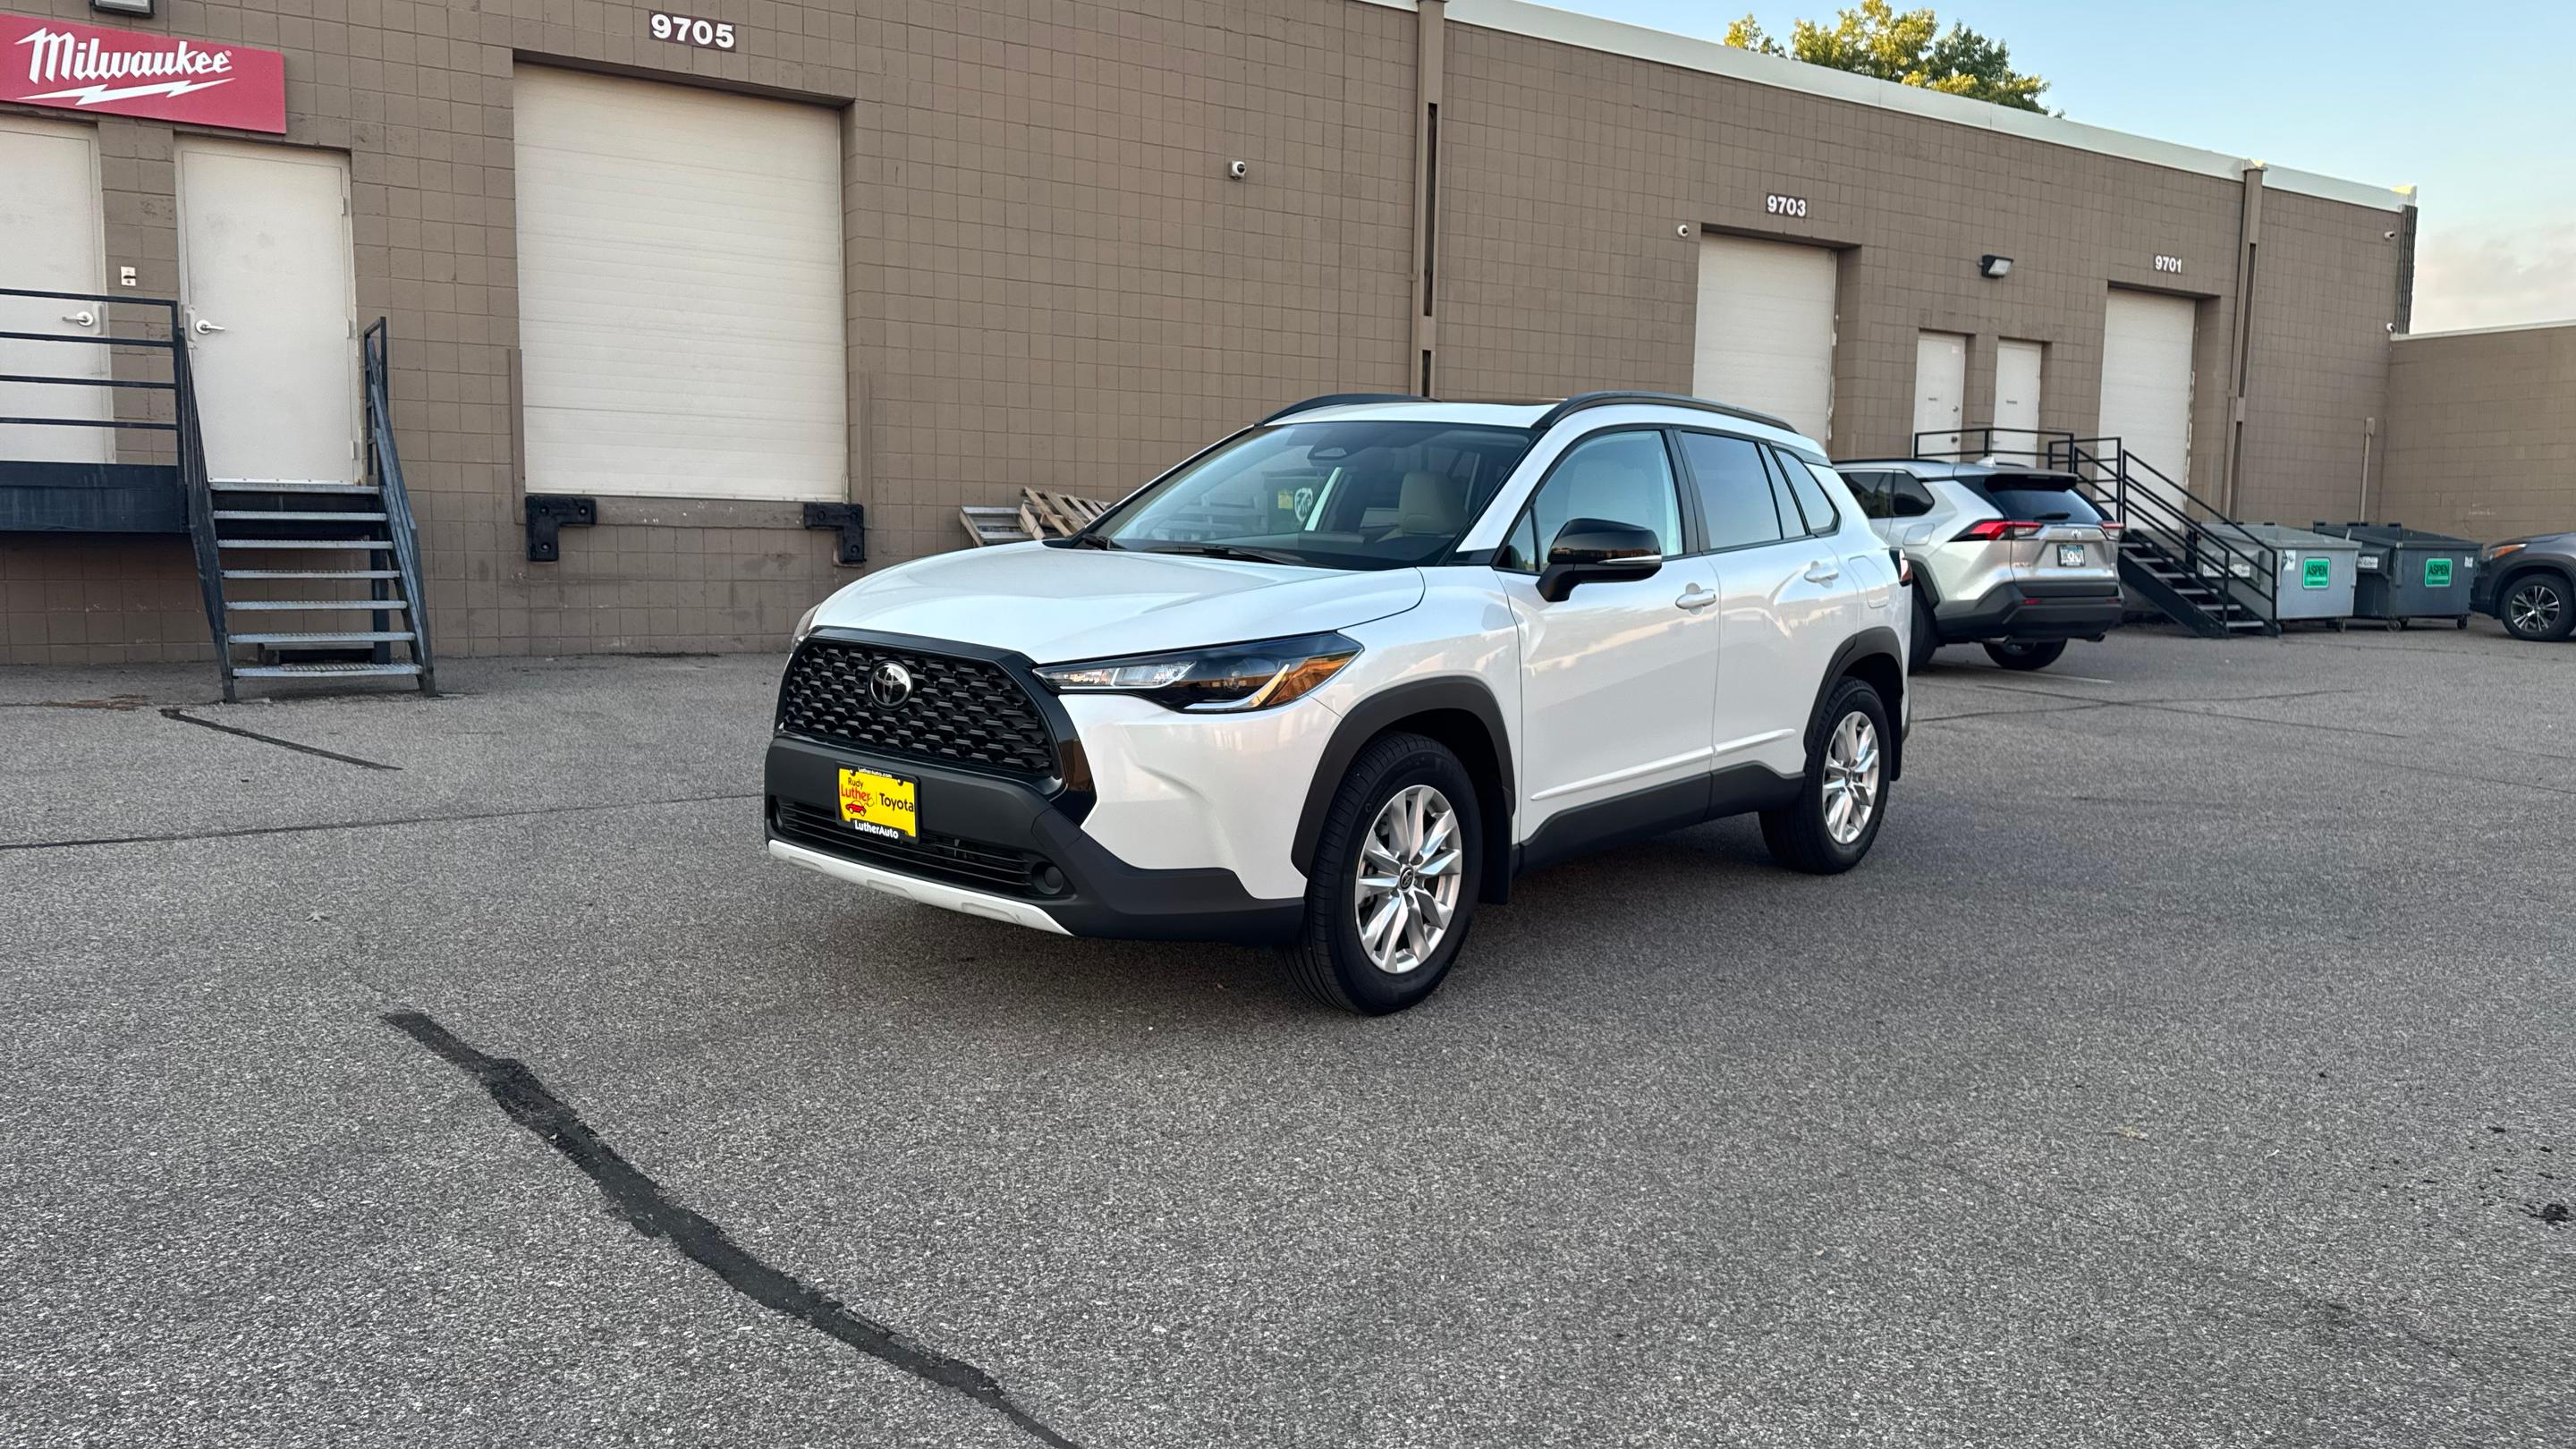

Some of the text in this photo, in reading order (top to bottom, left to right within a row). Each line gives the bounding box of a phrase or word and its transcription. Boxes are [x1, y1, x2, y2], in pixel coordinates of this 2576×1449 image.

[651, 13, 734, 48] 9705
[14, 27, 233, 84] Milwaukee
[1767, 194, 1806, 217] 9703
[2155, 254, 2182, 274] 9701
[2307, 564, 2327, 577] ASPEN
[2428, 564, 2450, 575] ASPEN
[841, 784, 871, 802] Luther
[847, 777, 864, 790] Rudy
[879, 792, 914, 812] Toyota
[854, 819, 899, 839] LutherAuto
